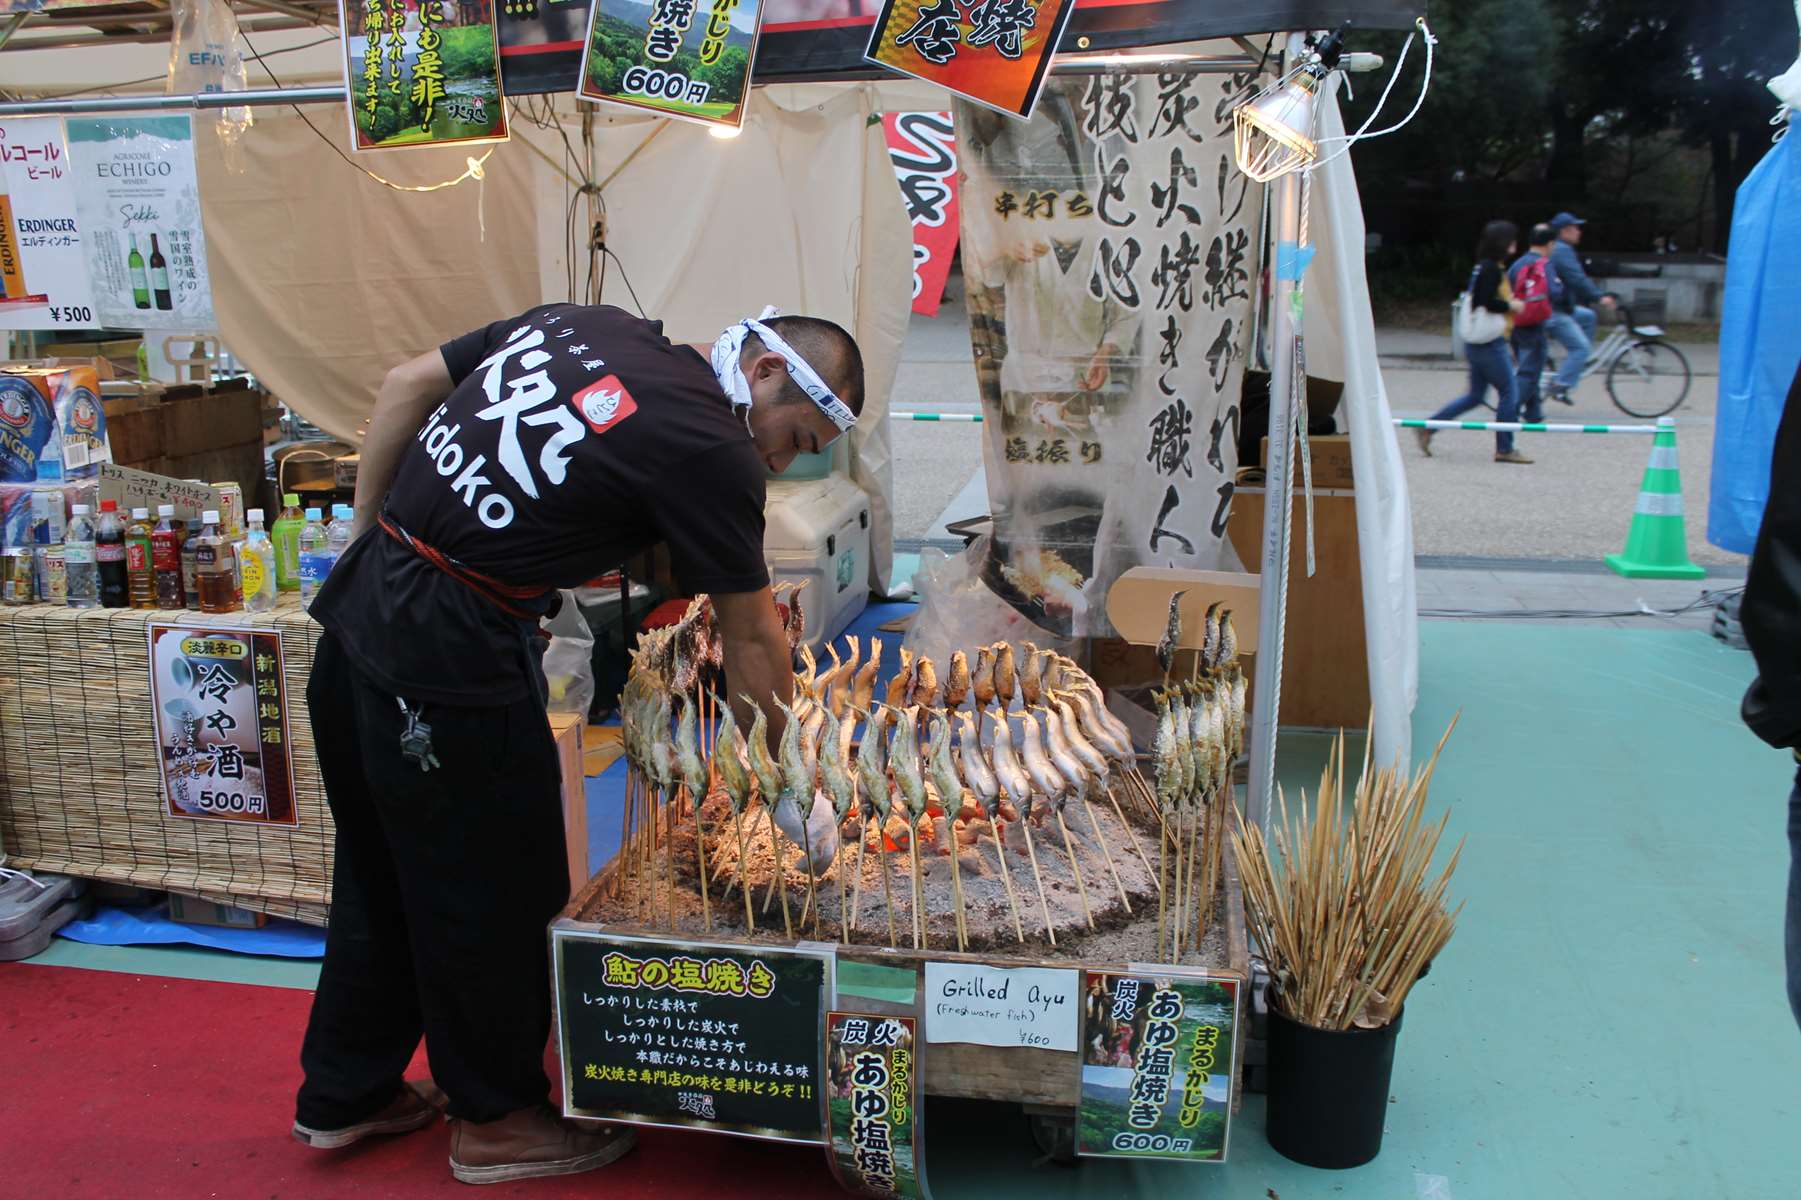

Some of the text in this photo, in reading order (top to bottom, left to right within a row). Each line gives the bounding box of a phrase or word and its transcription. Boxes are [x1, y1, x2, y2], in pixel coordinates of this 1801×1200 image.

[646, 0, 694, 61] 焼き
[624, 67, 709, 104] 600円
[28, 166, 62, 180] ビール
[96, 161, 171, 177] ECHIGO
[1086, 74, 1141, 307] 技と心
[120, 204, 160, 229] Sekki
[995, 191, 1093, 219] 串打ち
[18, 218, 78, 232] ERDINGER
[21, 236, 79, 247] エルディンガー
[51, 307, 91, 322] ¥500
[1146, 73, 1203, 566] 炭火焼き職人
[1006, 438, 1101, 464] 塩振り
[188, 640, 243, 656] 淡麗辛口
[256, 654, 281, 744] 新潟地酒
[198, 664, 245, 781] 冷や酒
[200, 790, 264, 813] 500円
[604, 953, 774, 997] 鮎の塩焼き
[583, 992, 699, 1013] しっかりした素材で
[943, 976, 1064, 1011] Grilled Ayu
[1112, 980, 1138, 1020] 炭火
[623, 1014, 739, 1035] しっかりした炭火で
[937, 1003, 1035, 1022] (Freshwater fish)
[604, 1030, 747, 1054] しっかりとした焼き方で
[843, 1020, 898, 1045] 炭火
[1019, 1028, 1050, 1045] ¥600
[636, 1050, 809, 1079] 本職だからこそあじわえる味
[1130, 991, 1182, 1127] あゆ塩焼き
[891, 1050, 908, 1125] まるかじり
[1180, 1026, 1218, 1127] まるかじり
[852, 1053, 895, 1191] あゆ塩焼き
[1113, 1133, 1192, 1152] 600円
